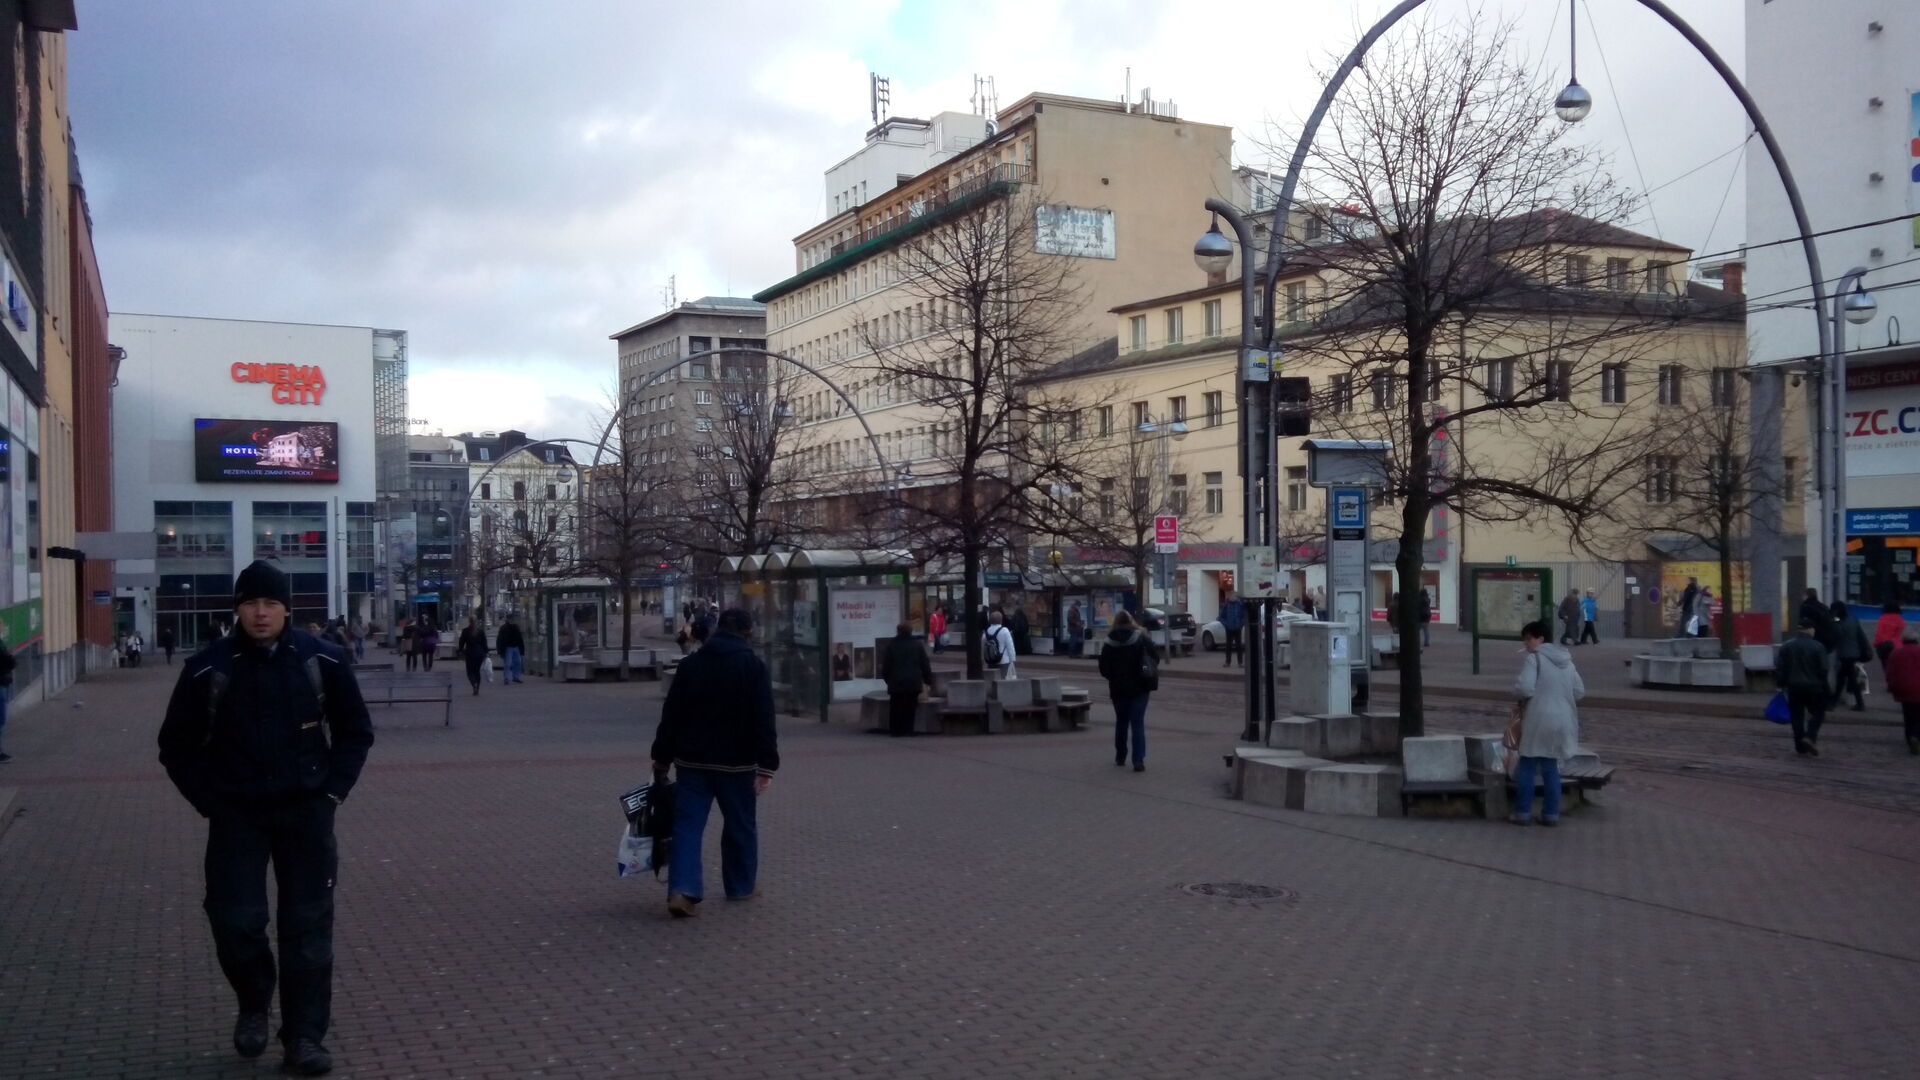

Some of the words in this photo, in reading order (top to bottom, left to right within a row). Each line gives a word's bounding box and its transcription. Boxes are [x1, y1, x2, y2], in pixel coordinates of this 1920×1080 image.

[231, 362, 324, 384] CINEMA
[1884, 369, 1919, 384] CENY
[272, 384, 326, 405] CITY
